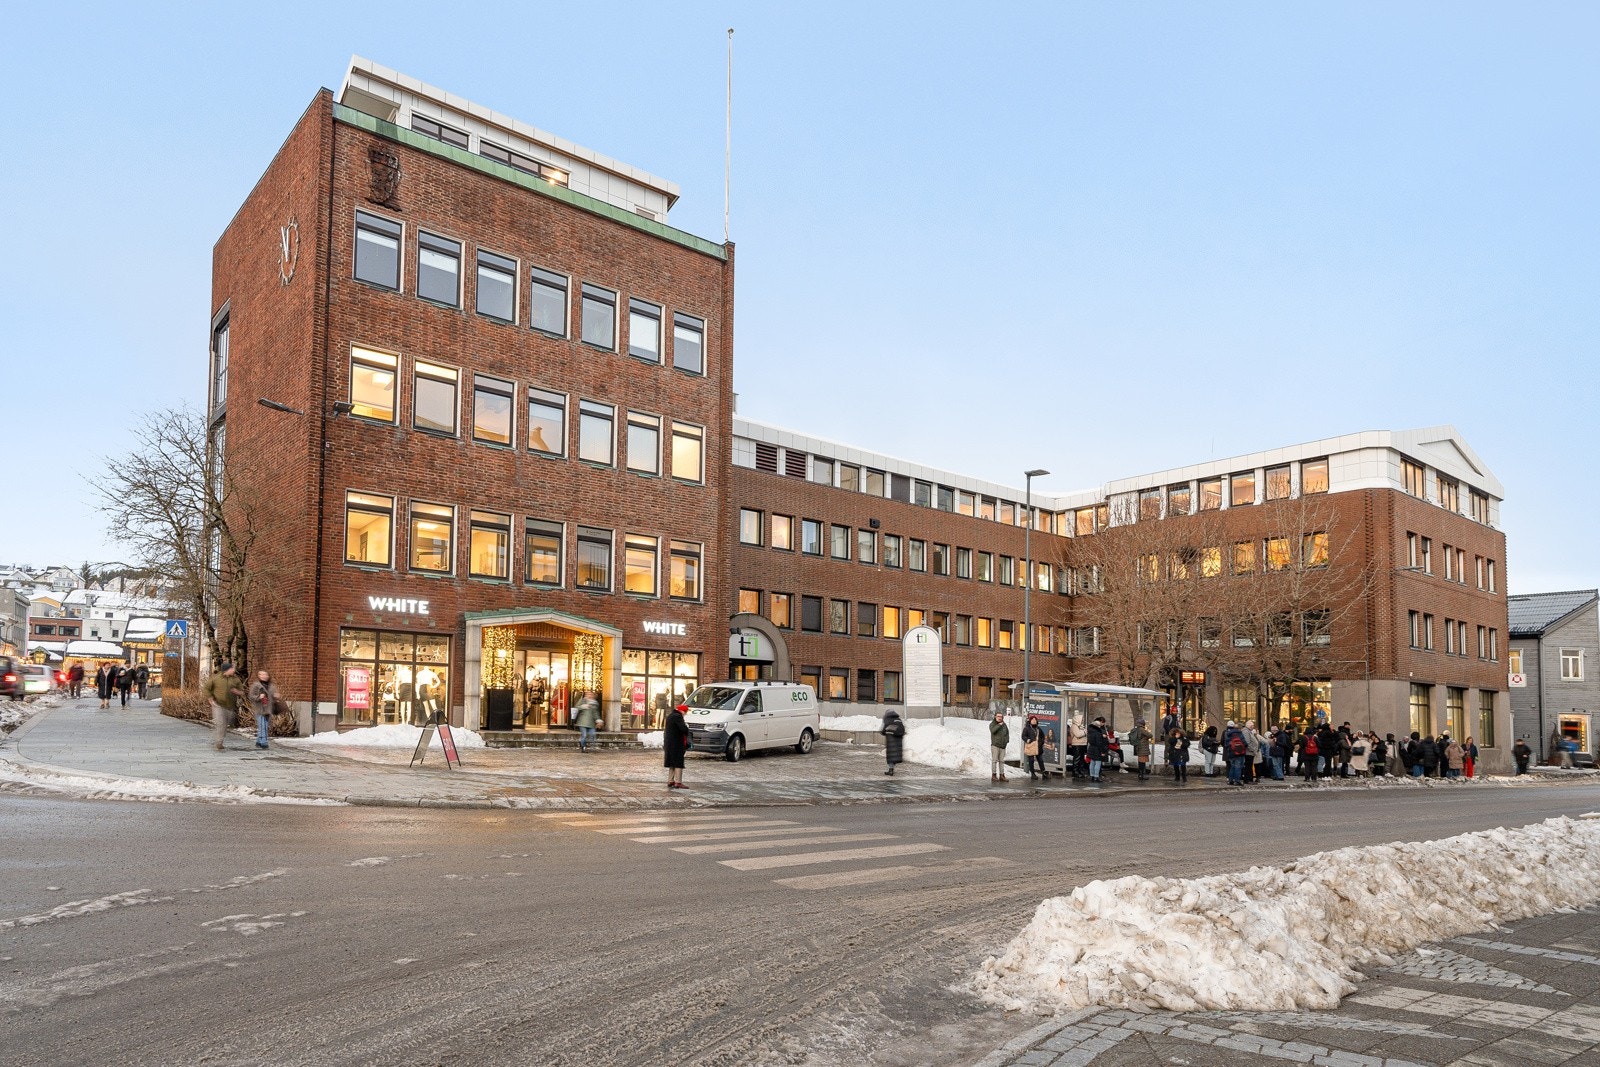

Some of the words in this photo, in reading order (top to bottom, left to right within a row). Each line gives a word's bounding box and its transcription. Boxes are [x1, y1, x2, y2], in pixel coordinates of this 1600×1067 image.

[368, 596, 430, 614] WHITE
[642, 620, 687, 636] WHITE
[349, 692, 367, 704] 50%
